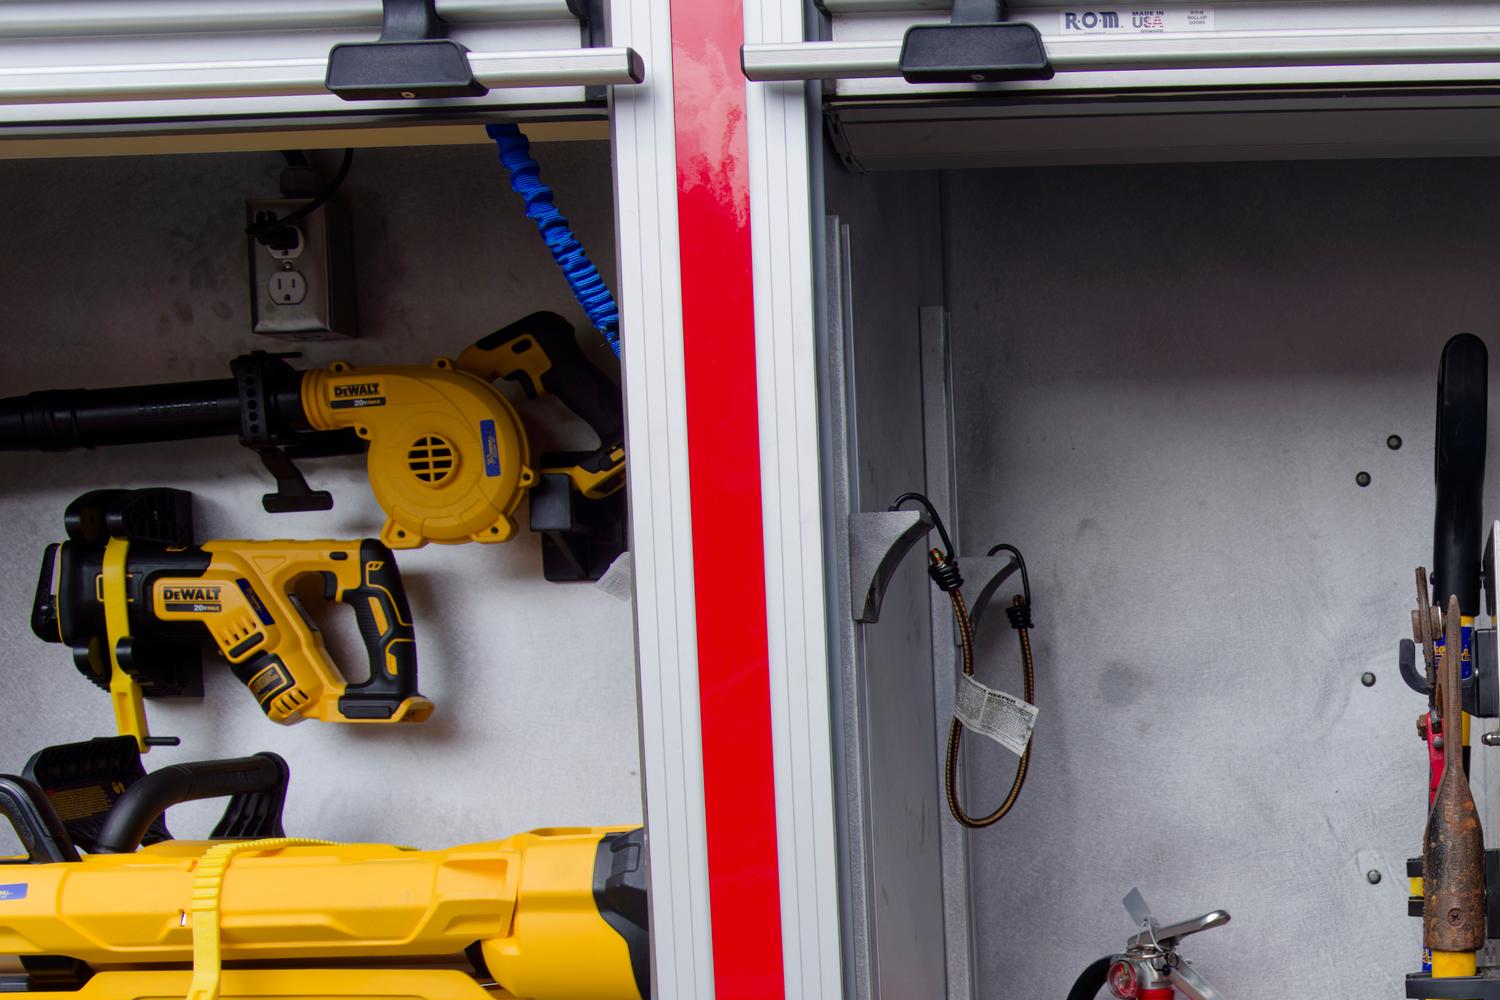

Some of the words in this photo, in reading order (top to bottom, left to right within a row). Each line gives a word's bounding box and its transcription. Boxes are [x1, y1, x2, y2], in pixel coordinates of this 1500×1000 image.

[1132, 16, 1164, 28] USA
[334, 383, 379, 397] DEWALT
[164, 588, 221, 600] DEWALT
